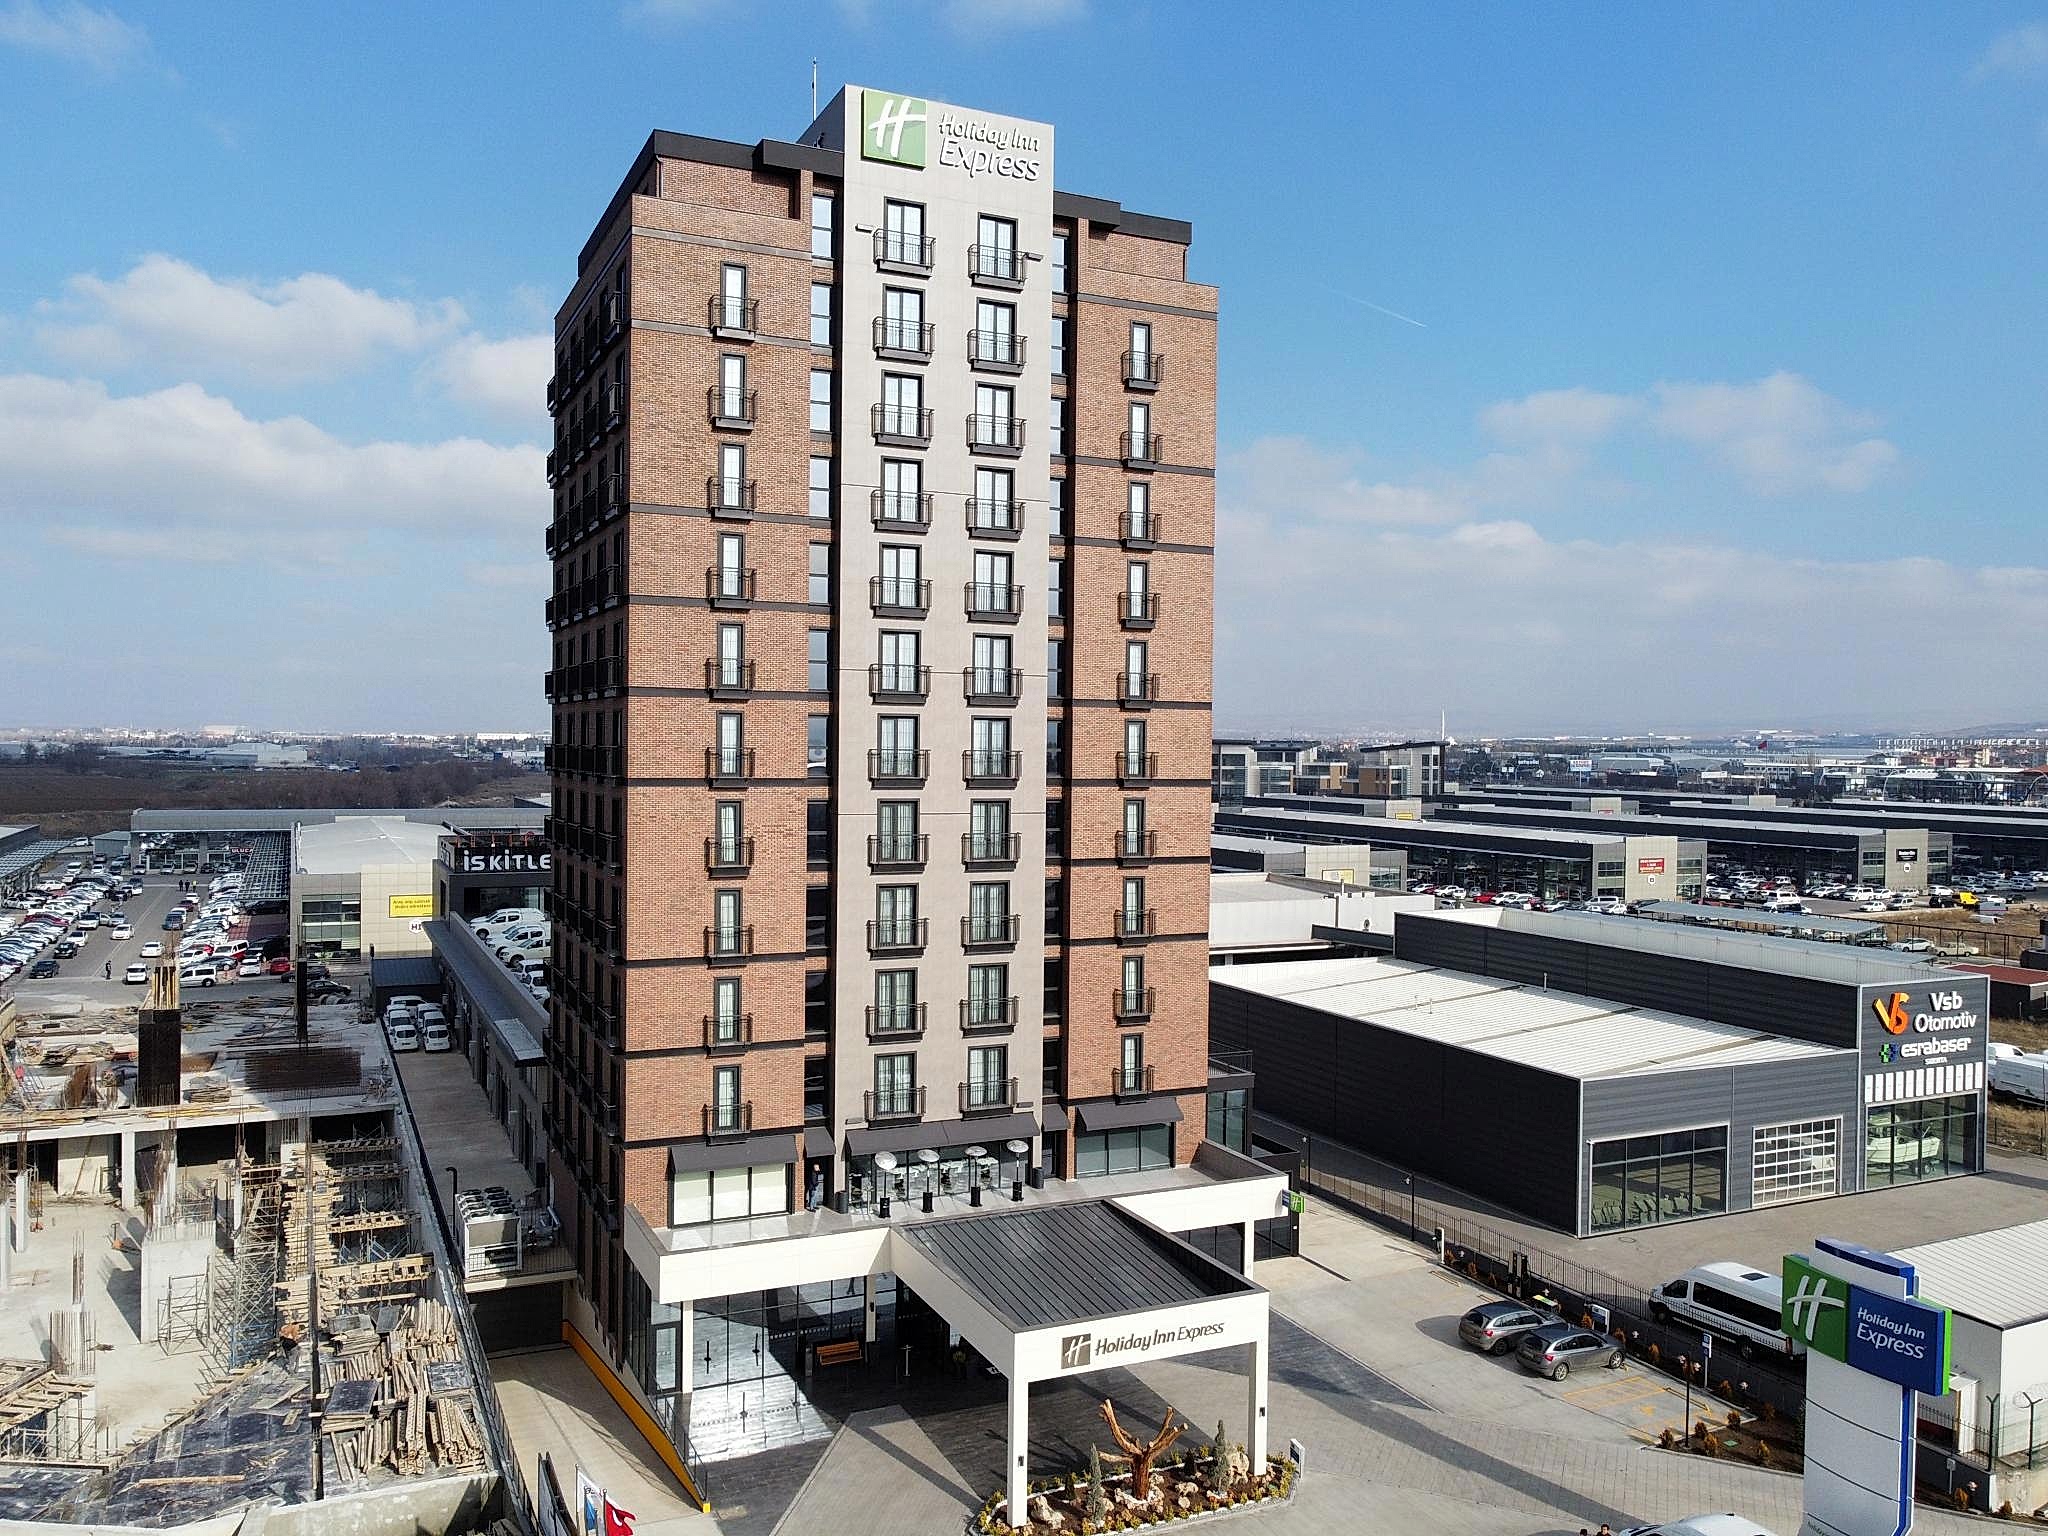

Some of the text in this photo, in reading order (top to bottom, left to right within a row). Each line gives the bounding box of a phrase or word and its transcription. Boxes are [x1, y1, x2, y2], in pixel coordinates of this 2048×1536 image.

[938, 111, 1040, 152] Holiday Inn
[939, 137, 1040, 182] Express
[1929, 991, 1962, 1012] Vsb
[1914, 1011, 1977, 1033] Otomotiv
[1095, 1333, 1152, 1357] Holiday
[1152, 1329, 1175, 1346] Inn
[1177, 1322, 1225, 1342] Express
[1856, 1306, 1925, 1340] Holiday Inn
[1856, 1323, 1925, 1360] Express
